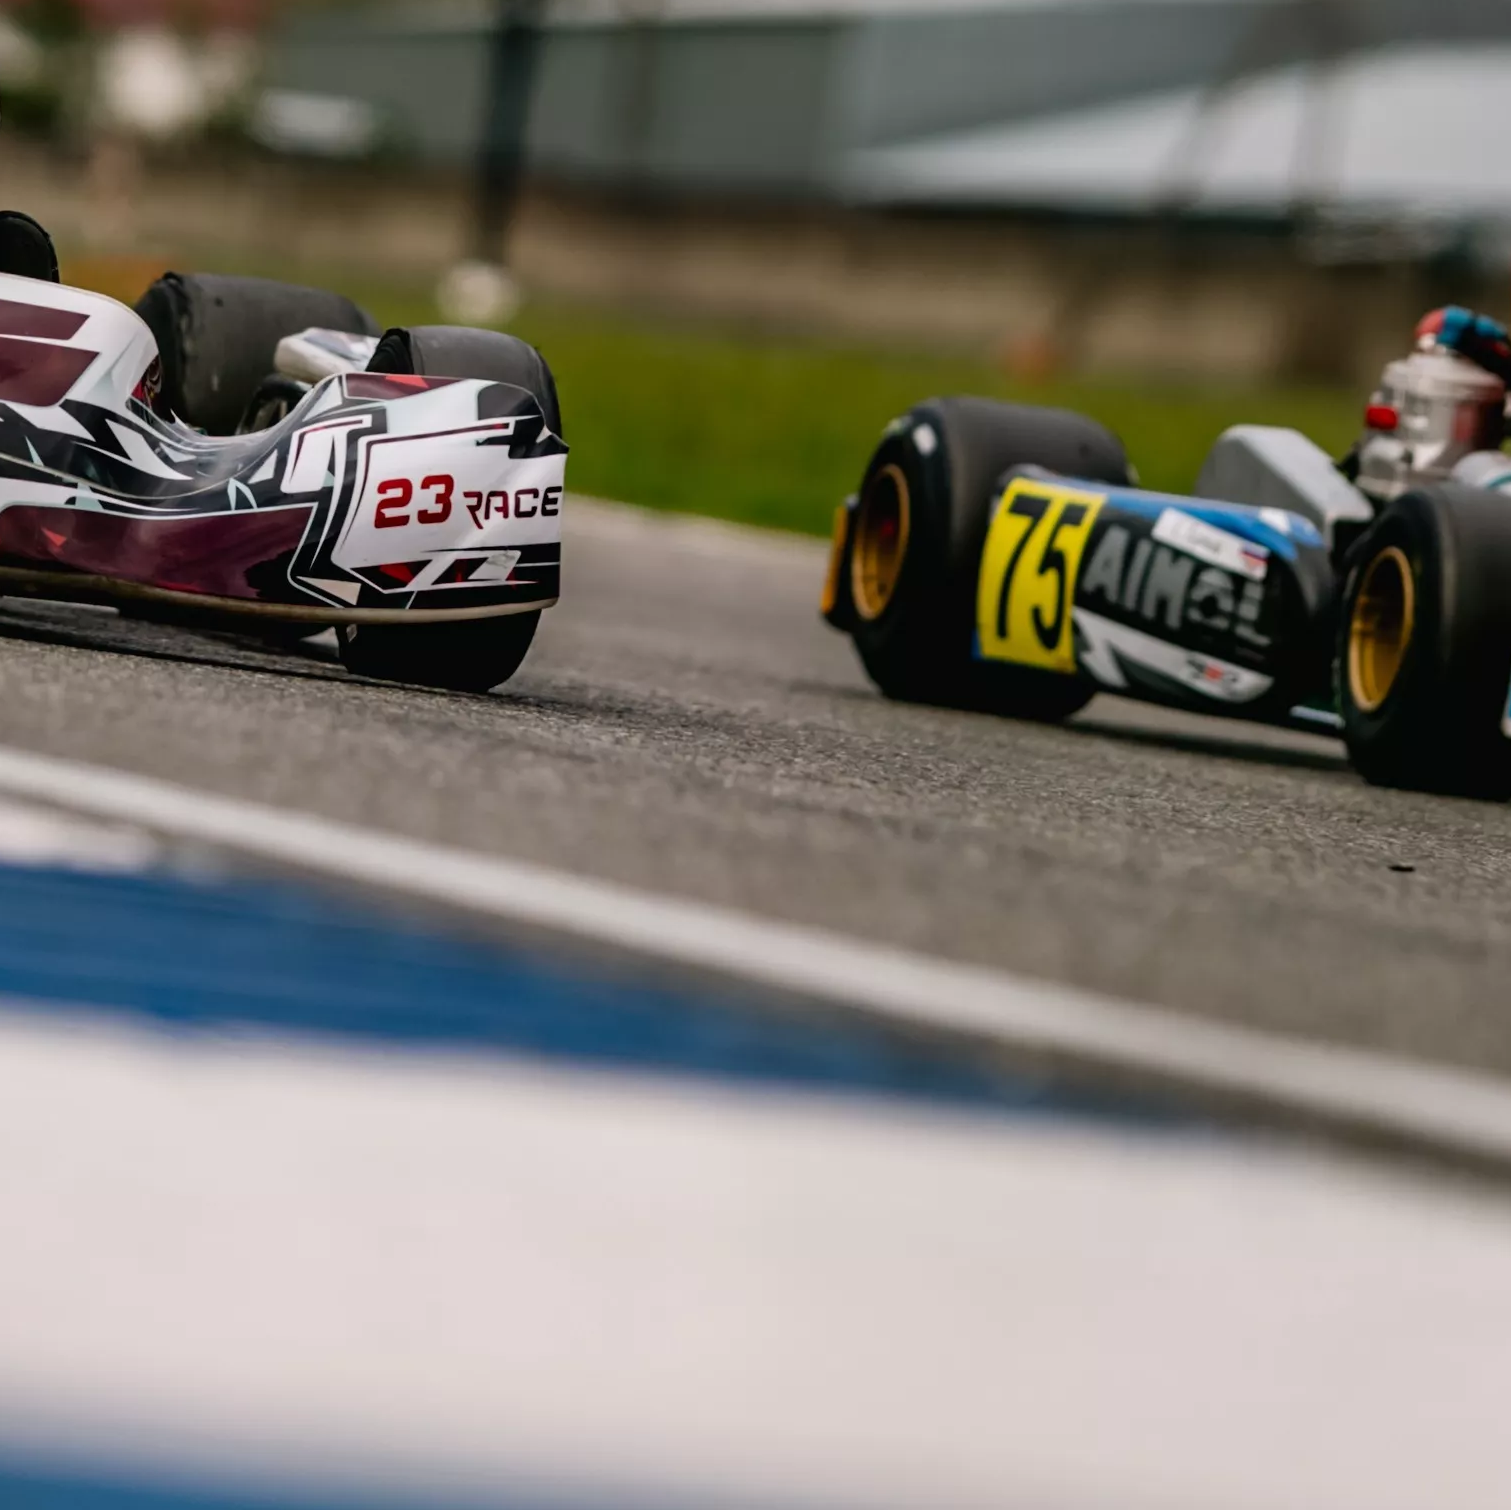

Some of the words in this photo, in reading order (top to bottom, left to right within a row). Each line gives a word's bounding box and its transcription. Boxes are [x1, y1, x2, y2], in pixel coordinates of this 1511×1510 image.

[373, 474, 455, 530] 23
[462, 485, 563, 530] RACE
[995, 493, 1091, 653] 75
